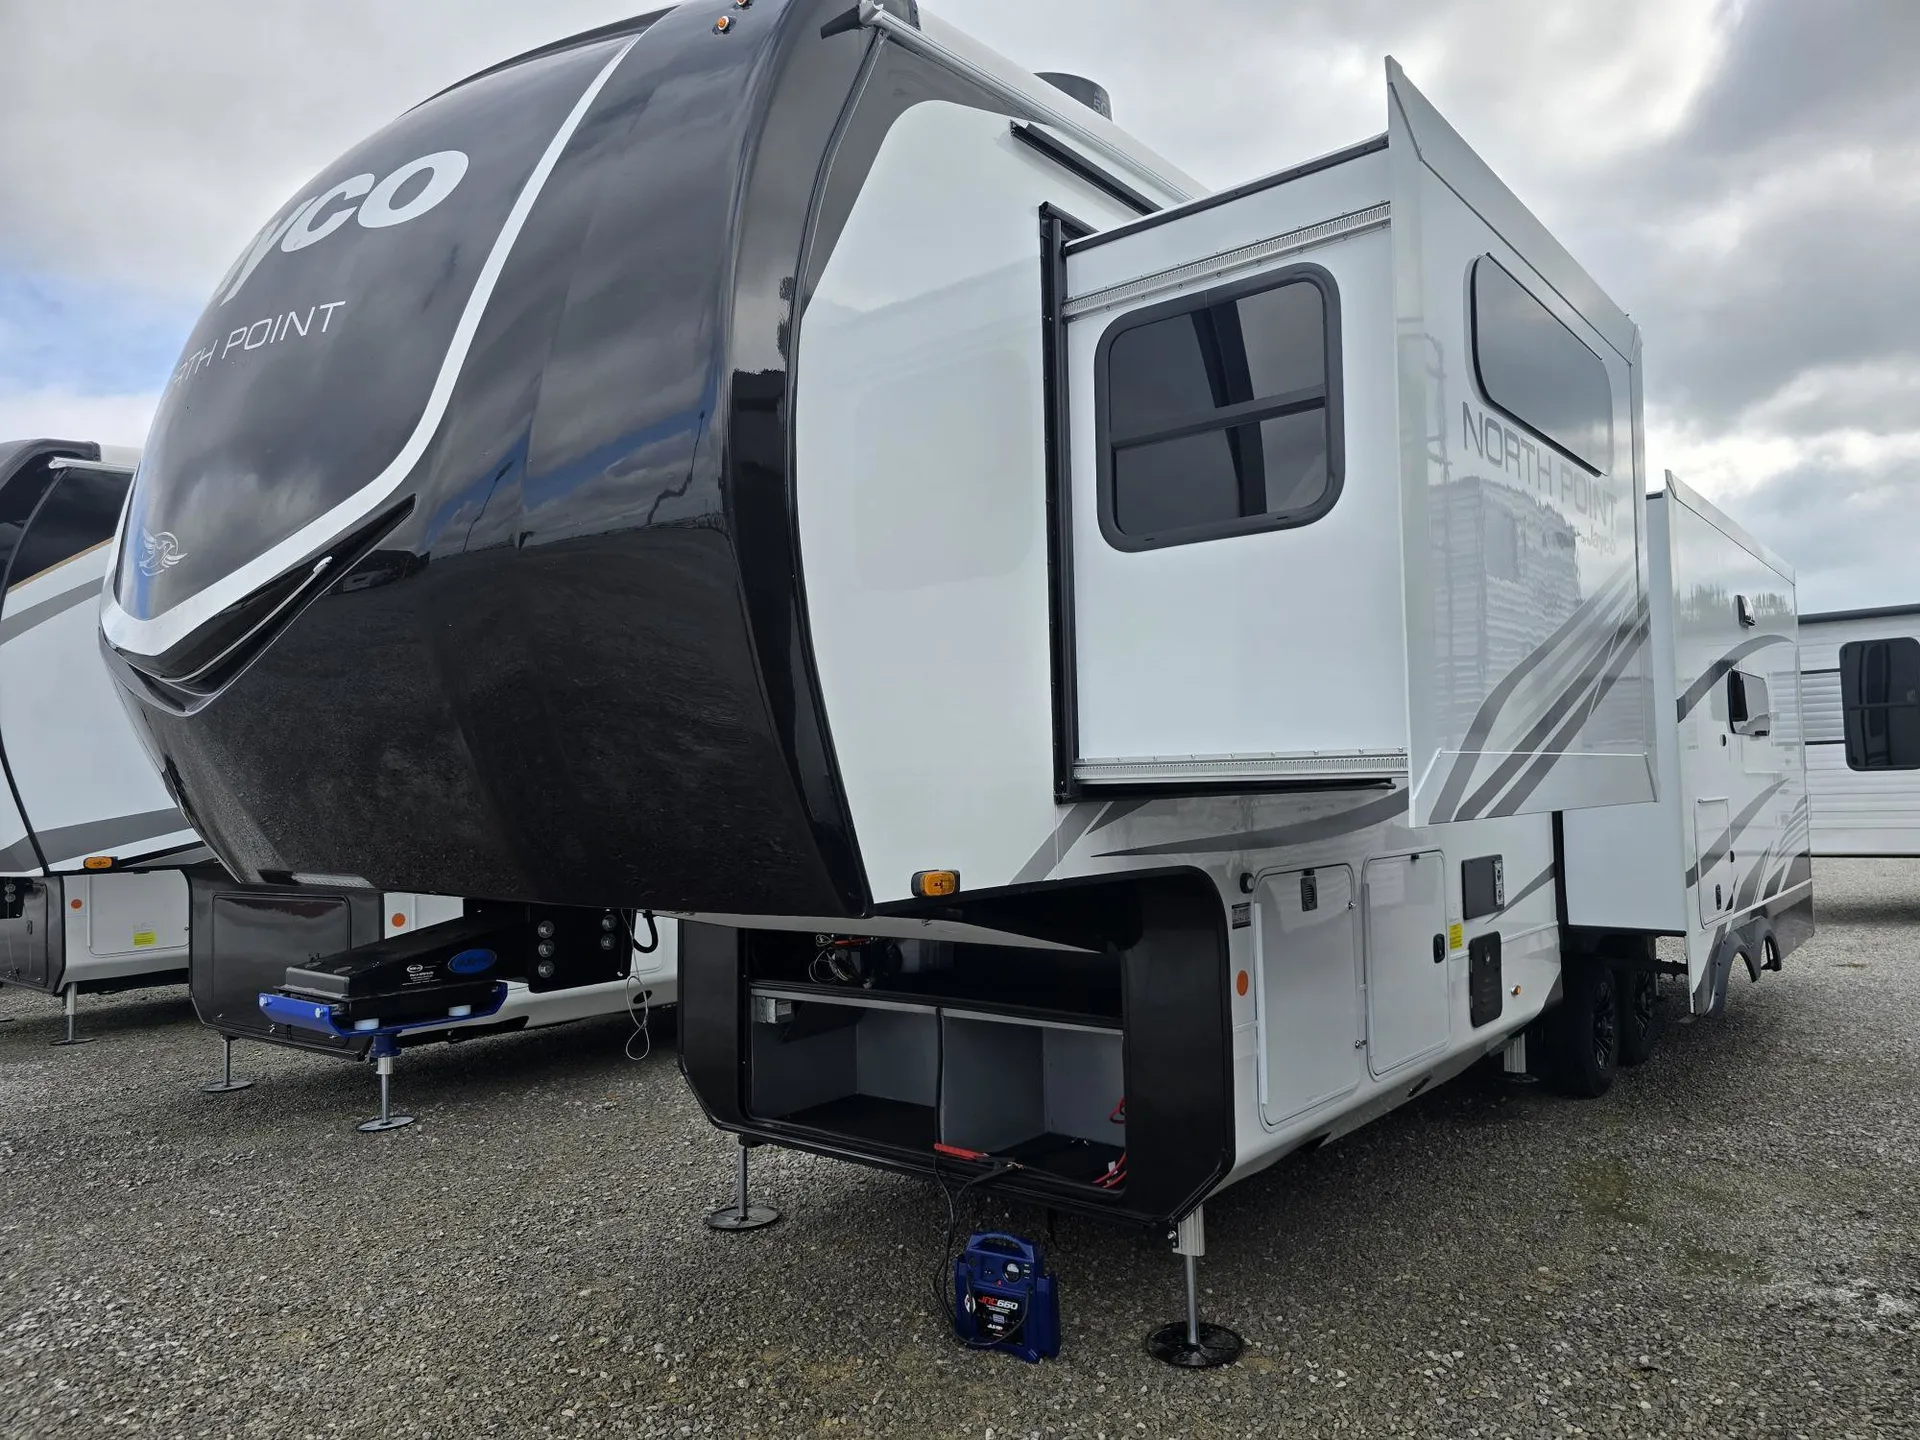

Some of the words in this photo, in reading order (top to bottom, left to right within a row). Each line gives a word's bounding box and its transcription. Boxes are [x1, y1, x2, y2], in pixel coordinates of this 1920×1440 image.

[212, 150, 469, 307] yco
[221, 300, 347, 359] POINT
[1462, 401, 1553, 497] NORTH
[1560, 463, 1617, 530] POINT
